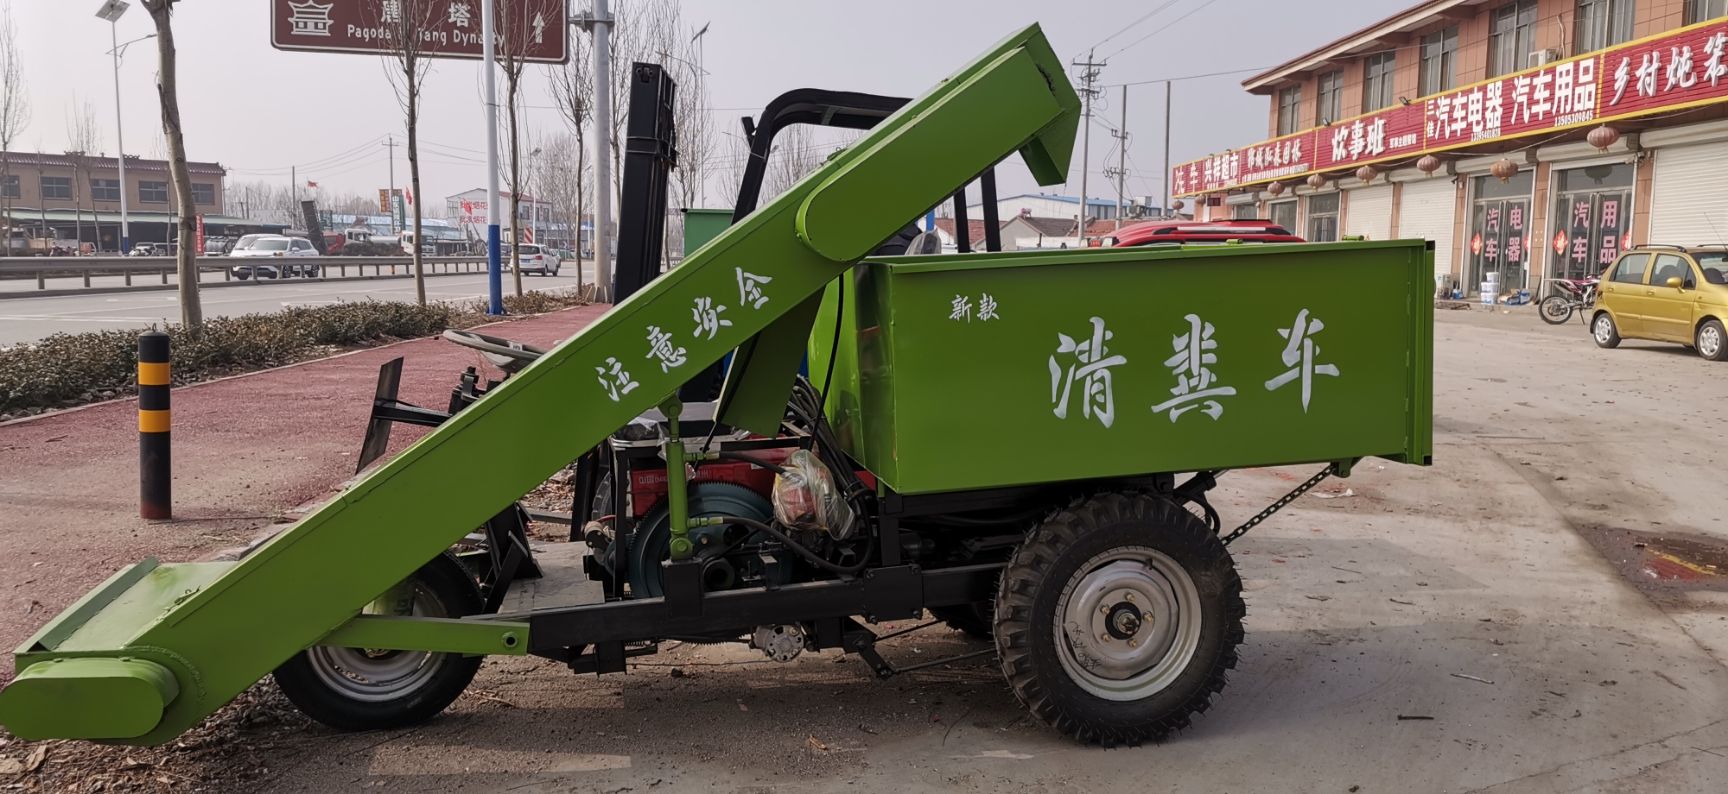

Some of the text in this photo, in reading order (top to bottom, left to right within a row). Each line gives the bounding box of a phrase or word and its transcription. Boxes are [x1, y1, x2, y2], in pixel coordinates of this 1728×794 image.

[347, 24, 391, 42] Pagoda
[418, 28, 447, 46] Tang
[453, 29, 504, 48] Dynaty
[1426, 100, 1435, 138] 三佳
[1435, 58, 1597, 140] 汽车电器 汽车用品
[1332, 116, 1387, 162] 炊事班
[949, 293, 1000, 323] 新款
[595, 267, 773, 402] 注意安全
